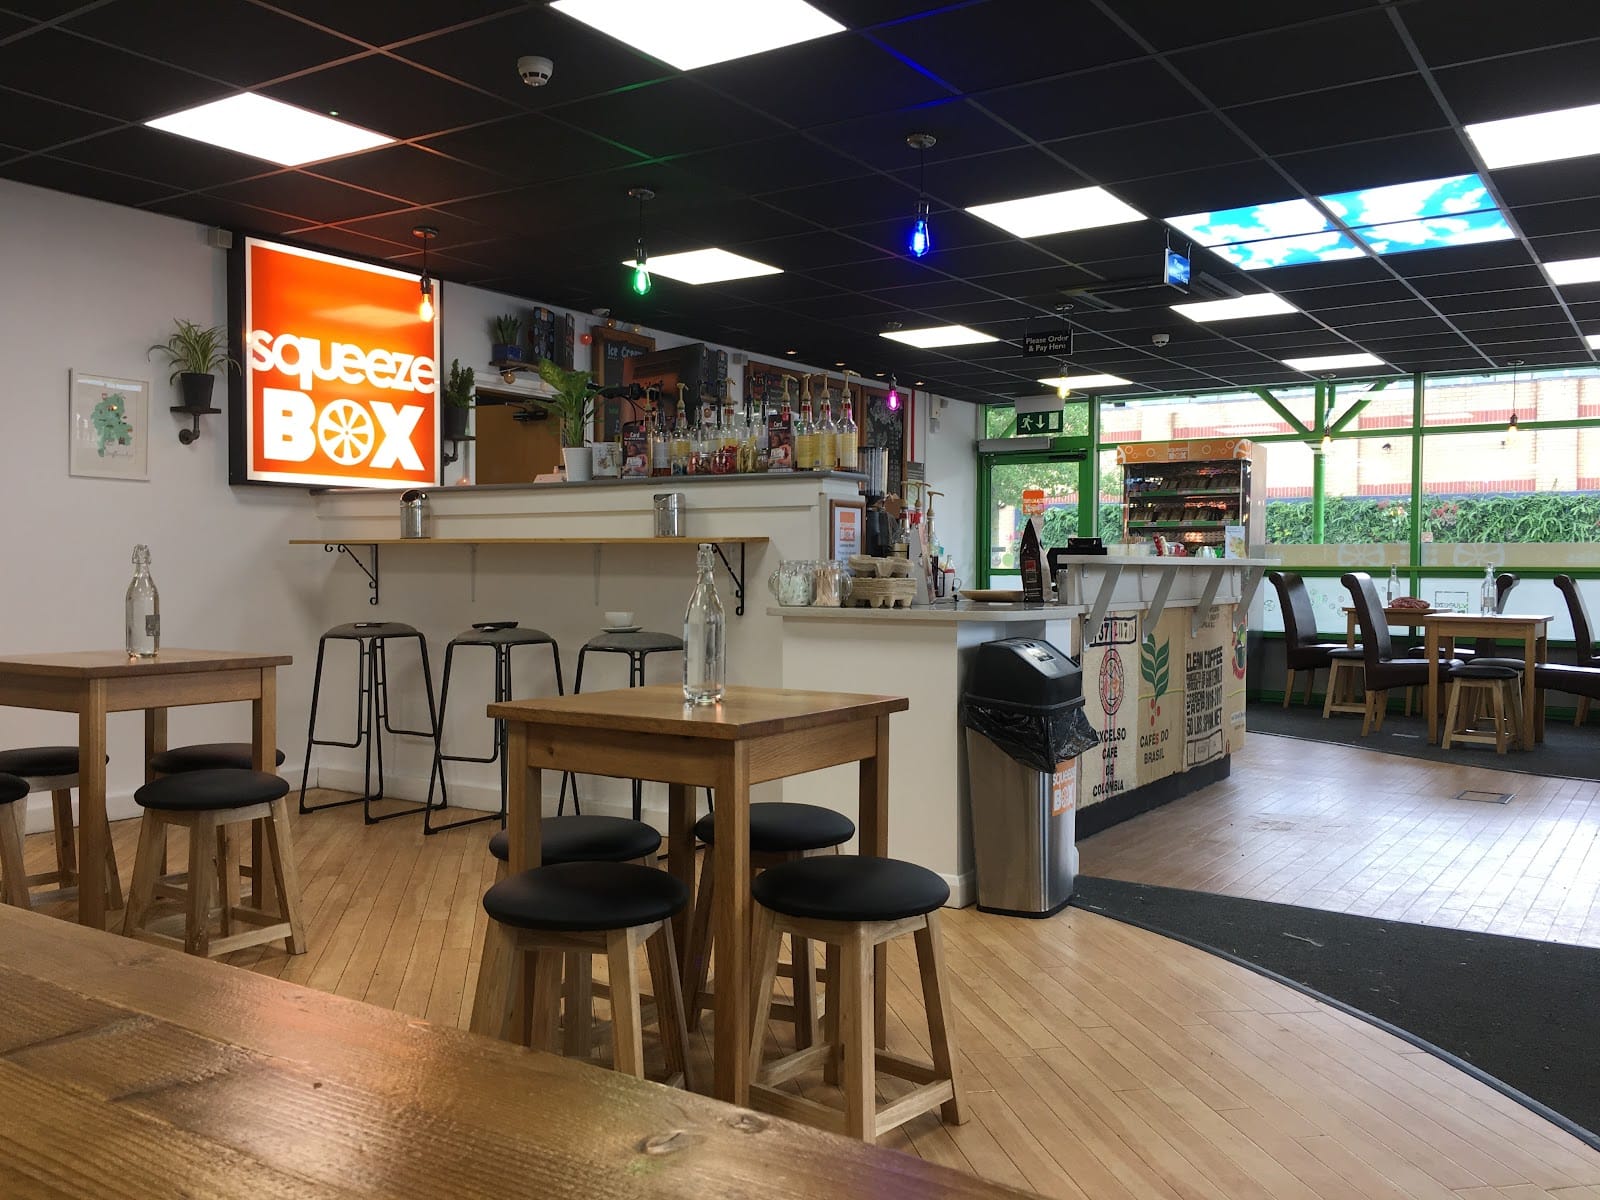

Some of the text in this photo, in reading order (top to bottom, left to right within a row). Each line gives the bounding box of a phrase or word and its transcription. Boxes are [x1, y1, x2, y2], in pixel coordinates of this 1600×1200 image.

[1025, 335, 1069, 345] Please Order
[1035, 344, 1048, 353] Pay
[1048, 343, 1066, 351] Here
[248, 330, 437, 393] squeeze
[263, 387, 425, 471] BOX
[1204, 646, 1223, 669] COFFEE
[1140, 729, 1169, 748] CAFES DO
[1102, 746, 1118, 760] CAFE
[1144, 748, 1165, 764] BRASIL
[1105, 764, 1115, 776] DE
[1092, 779, 1125, 797] COLOMBIA
